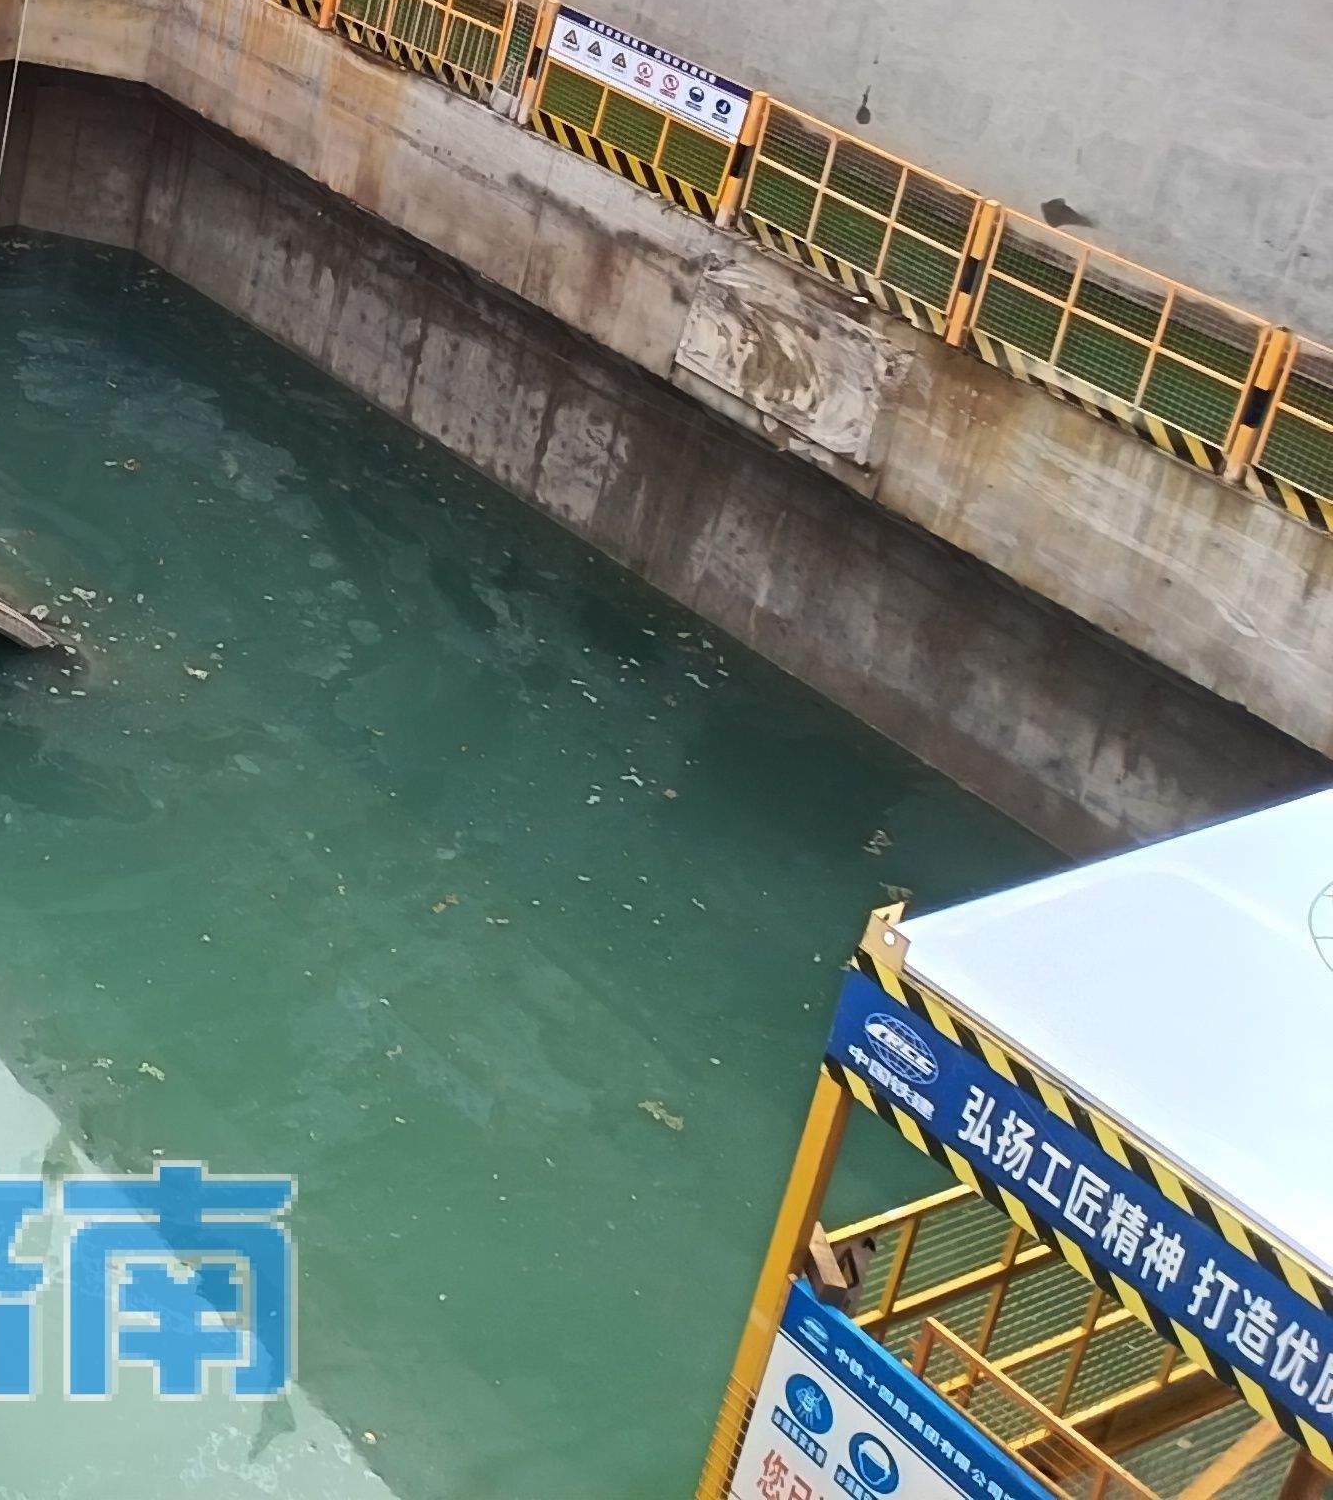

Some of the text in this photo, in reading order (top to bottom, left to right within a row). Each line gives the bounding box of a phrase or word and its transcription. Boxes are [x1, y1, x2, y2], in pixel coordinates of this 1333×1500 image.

[957, 1085, 1186, 1292] 弘扬工匠精神
